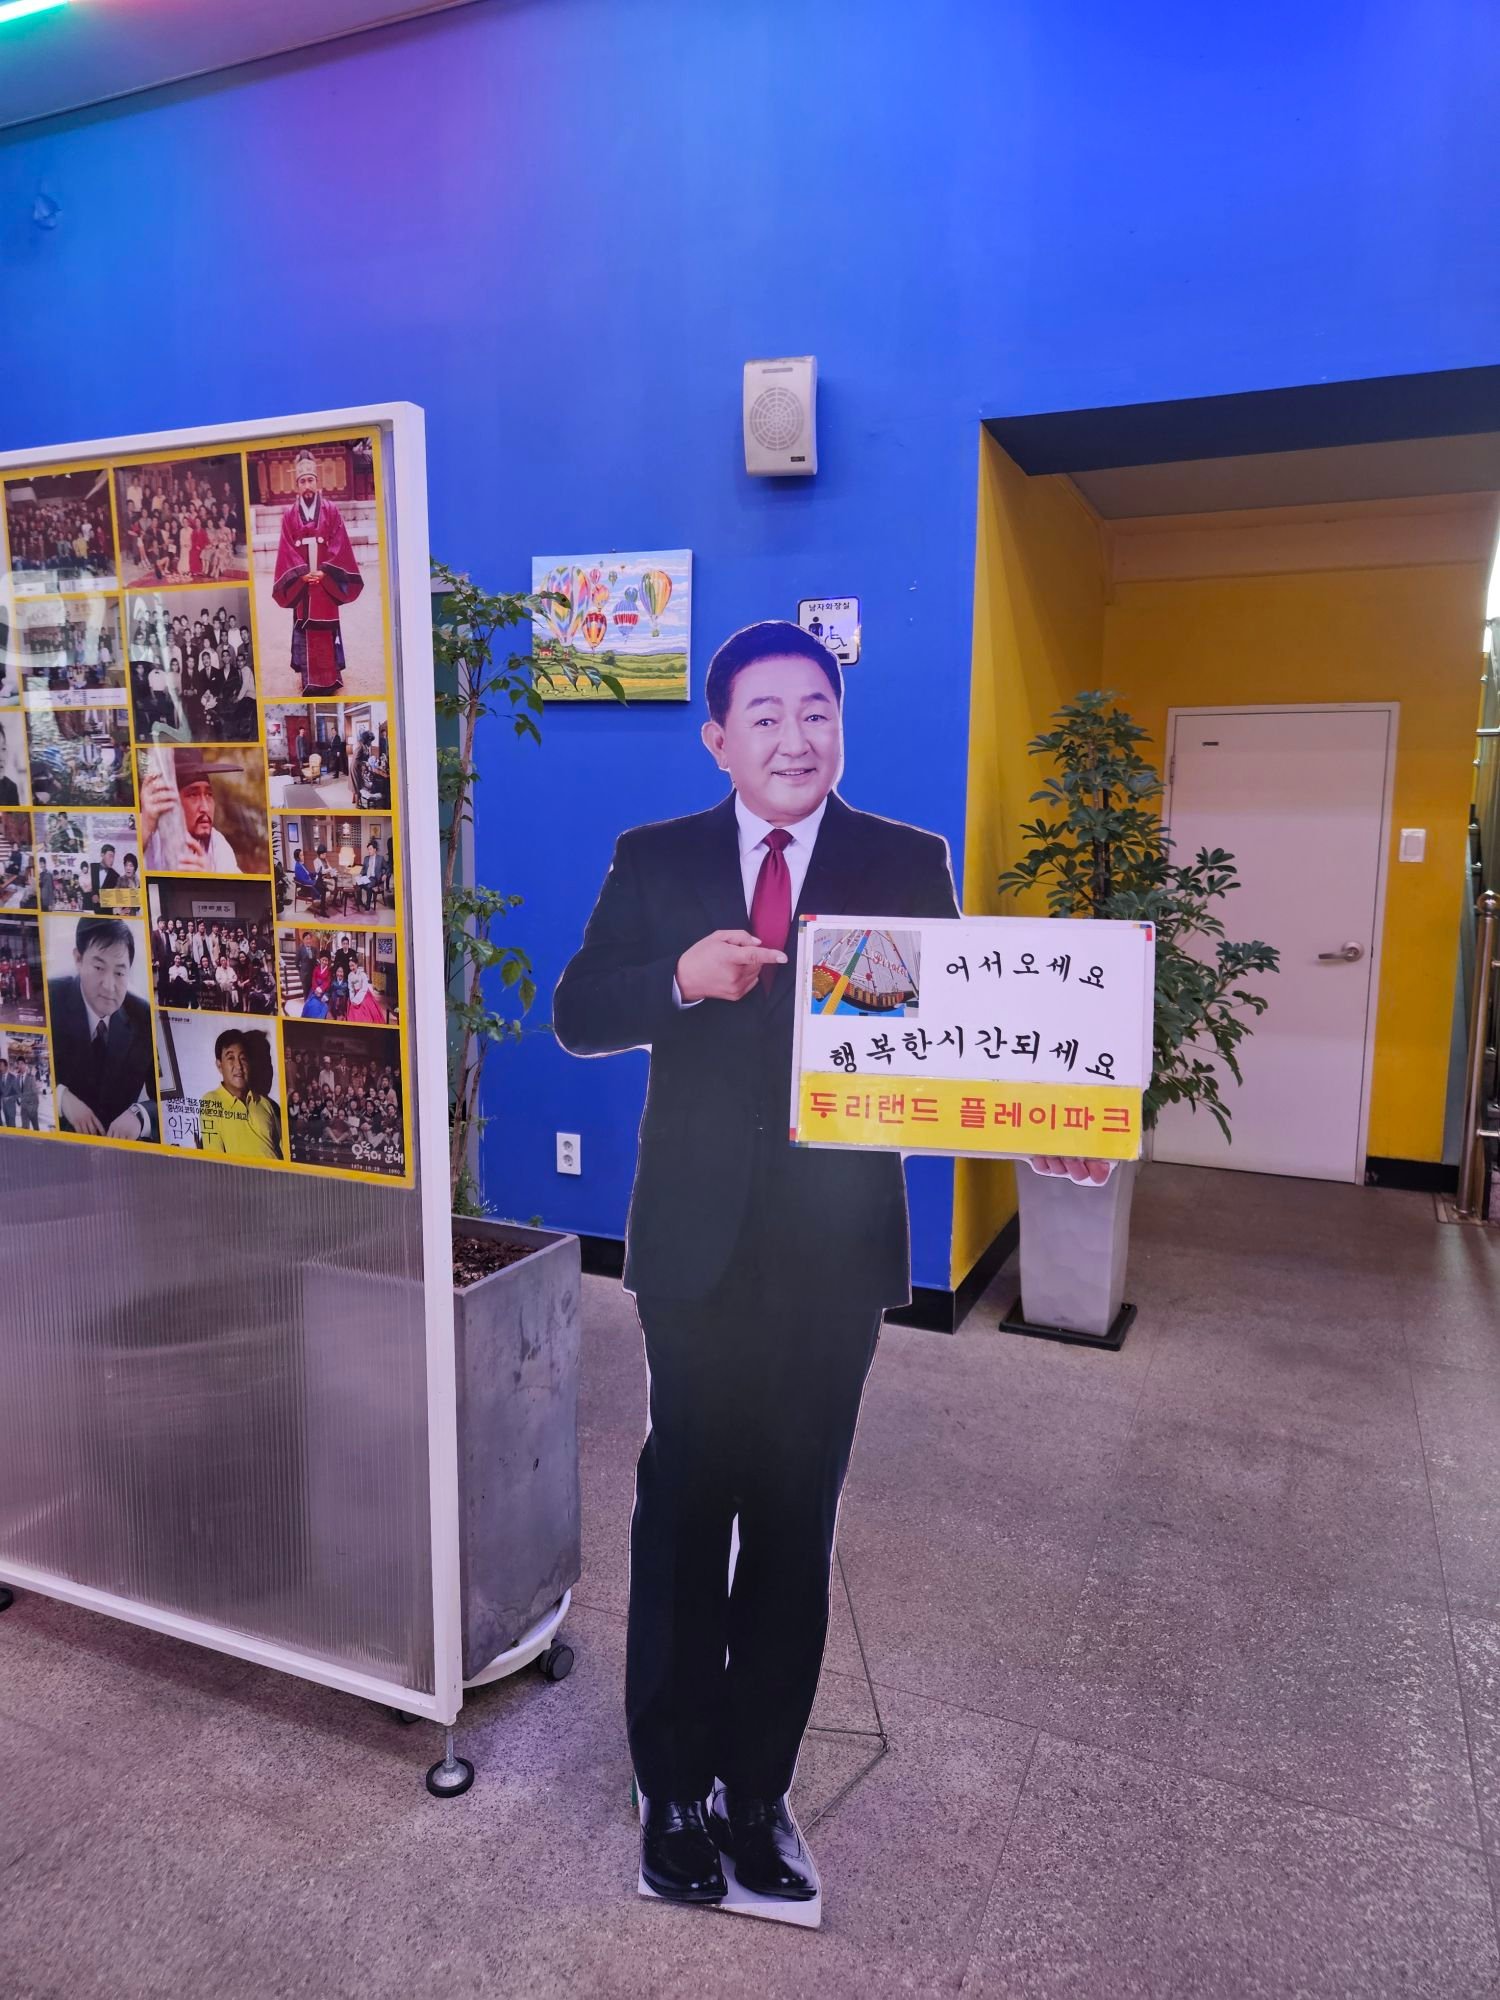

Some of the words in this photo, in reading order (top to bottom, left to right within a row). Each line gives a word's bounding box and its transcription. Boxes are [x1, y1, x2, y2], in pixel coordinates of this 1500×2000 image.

[808, 602, 850, 612] 남자화장실
[946, 951, 1105, 989] 어서오세요
[830, 1025, 1116, 1081] 행복한시간되세요
[168, 1114, 218, 1145] 임채무
[810, 1092, 940, 1124] 두리랜드
[959, 1097, 1132, 1134] 플레이파크
